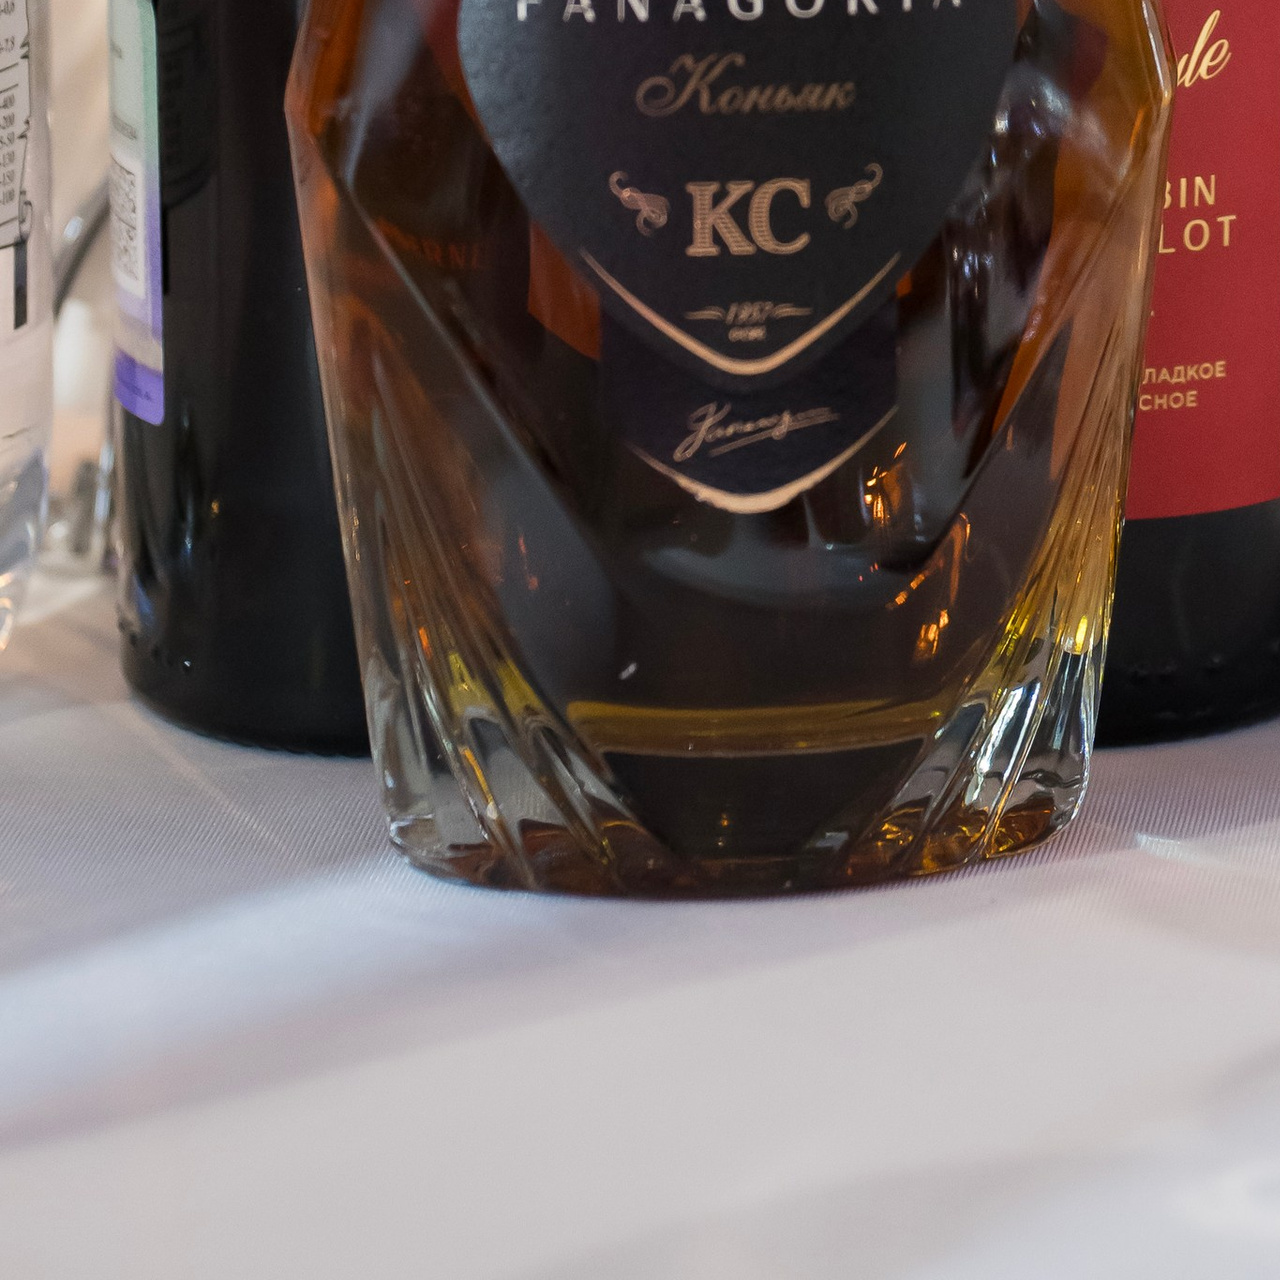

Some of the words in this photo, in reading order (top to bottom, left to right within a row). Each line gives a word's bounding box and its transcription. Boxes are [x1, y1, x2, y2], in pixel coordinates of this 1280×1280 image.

[634, 51, 857, 118] Коньяк
[1142, 360, 1227, 385] ЛАДКОЕ
[1138, 390, 1199, 412] СНОЕ
